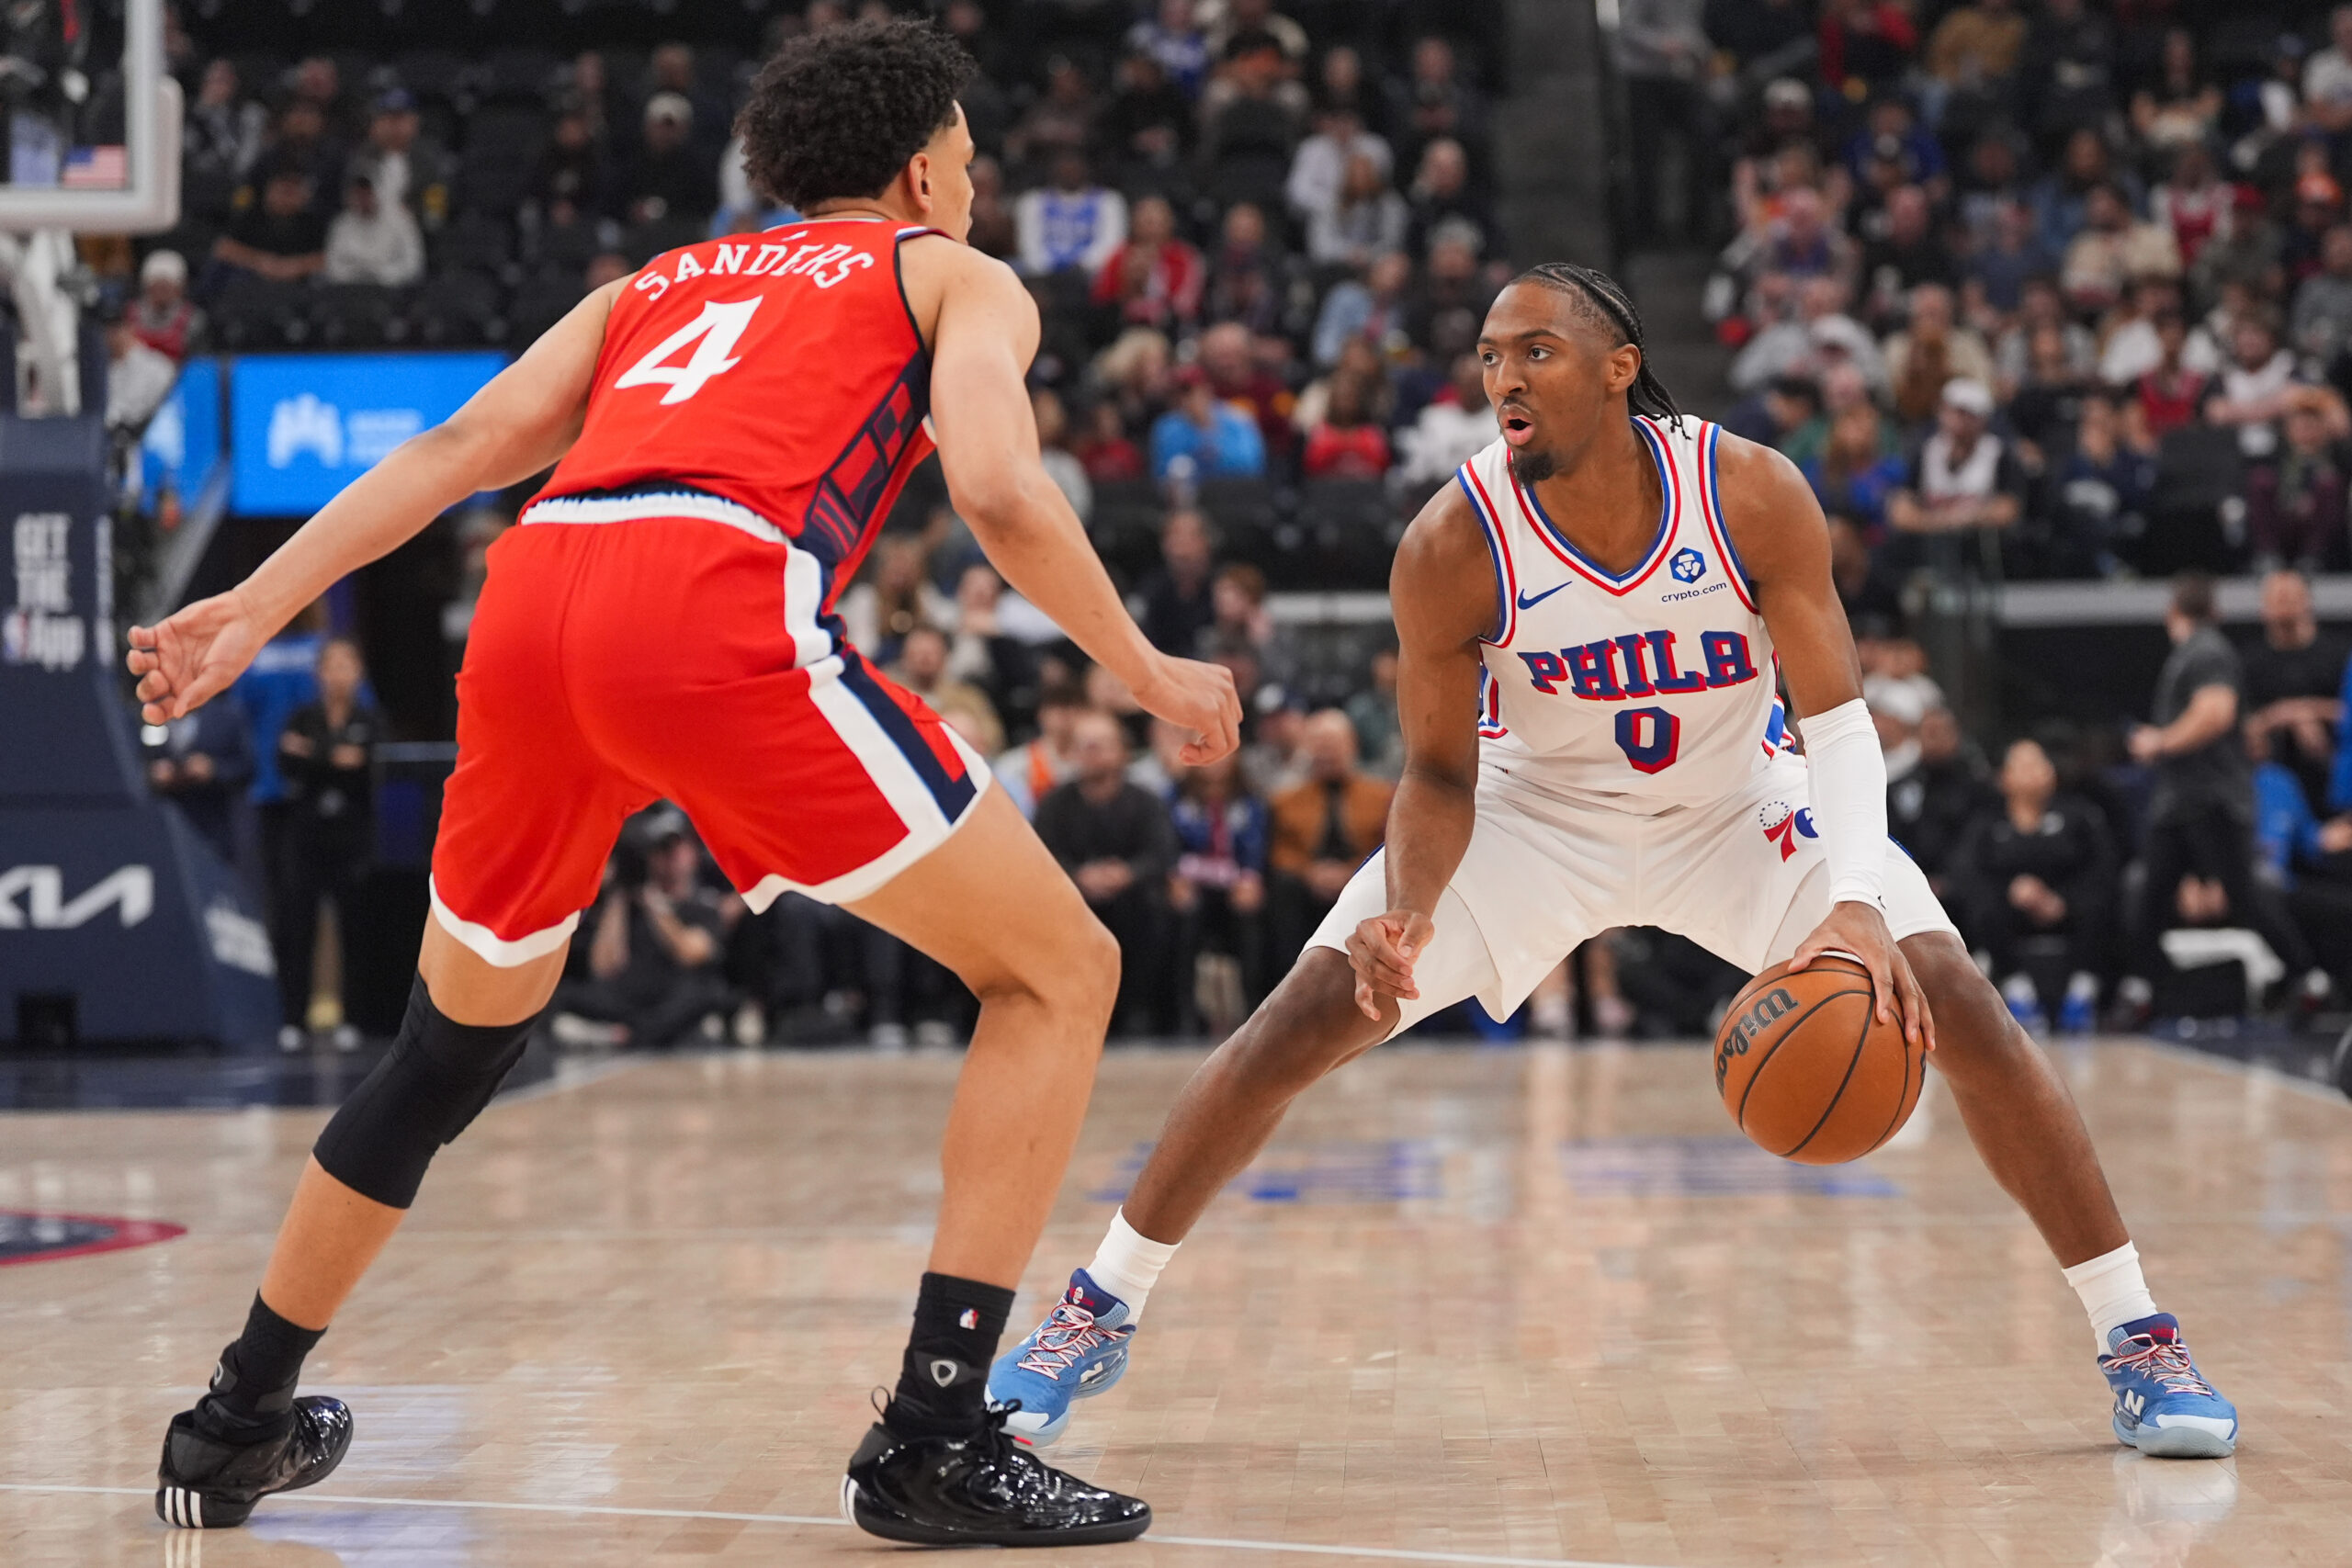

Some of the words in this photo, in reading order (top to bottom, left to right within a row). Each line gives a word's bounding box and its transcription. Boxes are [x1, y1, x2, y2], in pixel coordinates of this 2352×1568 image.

[635, 243, 875, 301] SANDERS
[614, 294, 763, 405] 4
[1661, 582, 1727, 603] crypto.com
[1517, 629, 1758, 702] PHILA
[1614, 705, 1680, 775] 0
[2124, 1388, 2145, 1416] N
